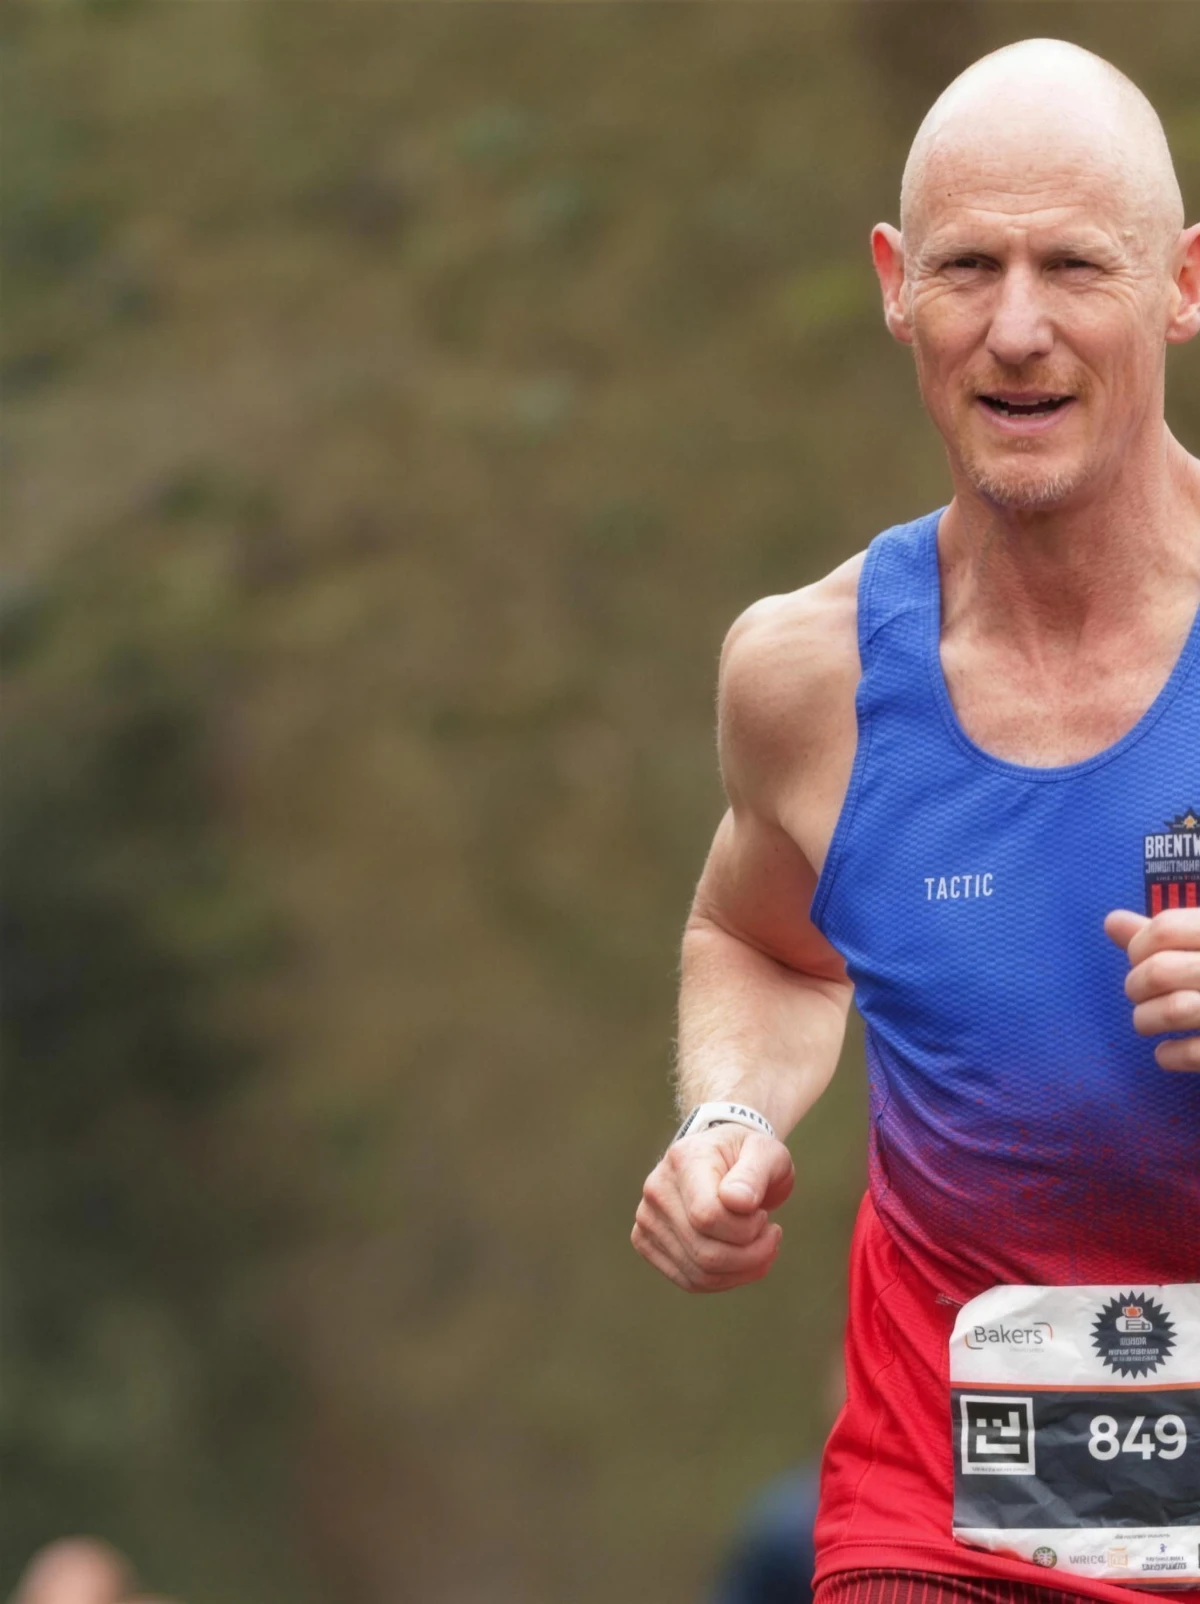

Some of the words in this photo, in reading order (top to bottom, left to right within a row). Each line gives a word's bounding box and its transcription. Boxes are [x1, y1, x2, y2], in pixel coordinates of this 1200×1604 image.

[924, 872, 993, 900] TACTIC
[973, 1324, 1044, 1345] Bakers
[1087, 1414, 1187, 1460] 849
